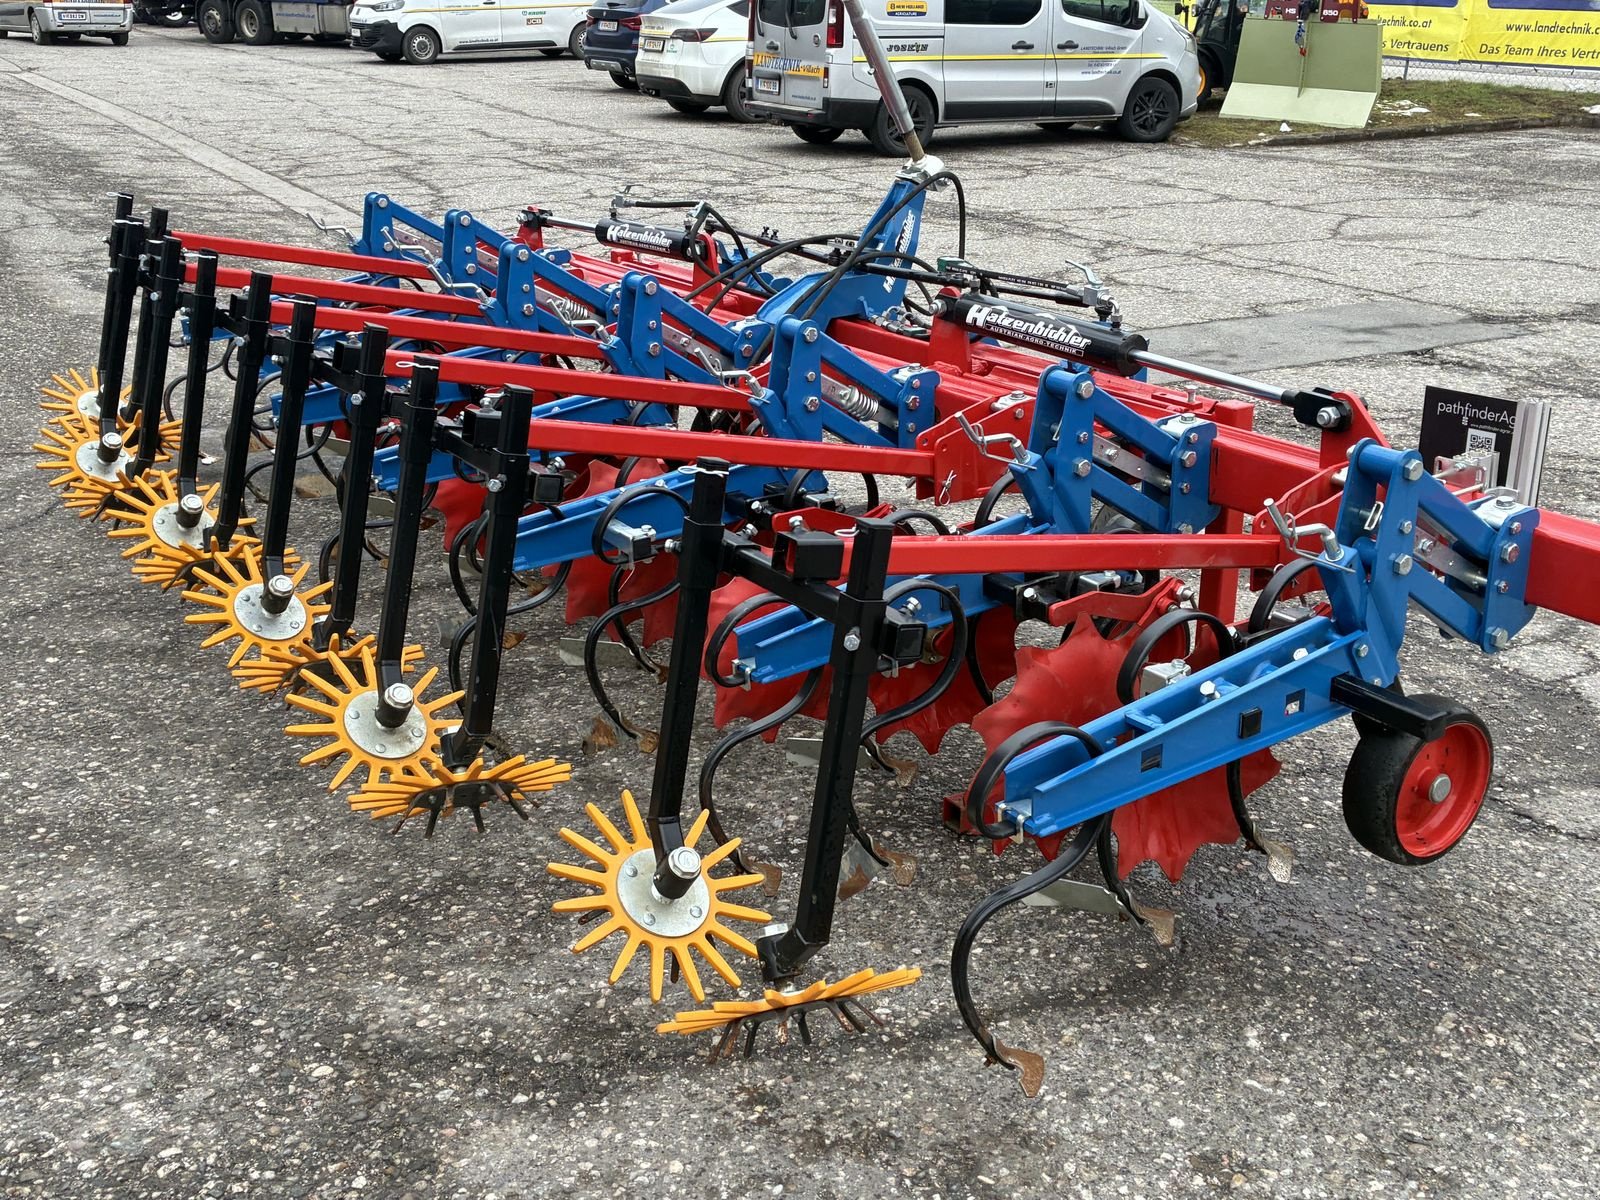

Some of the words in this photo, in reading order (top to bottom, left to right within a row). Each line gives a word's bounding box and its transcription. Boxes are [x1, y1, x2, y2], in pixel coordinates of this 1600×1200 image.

[886, 43, 928, 52] JOSKIN
[1390, 38, 1449, 52] Vertrauens
[1479, 44, 1500, 54] Das
[1504, 44, 1534, 56] Team
[1537, 46, 1567, 57] Ihres
[606, 224, 672, 248] Hatzenbichler
[966, 304, 1091, 350] Hatzenbichler
